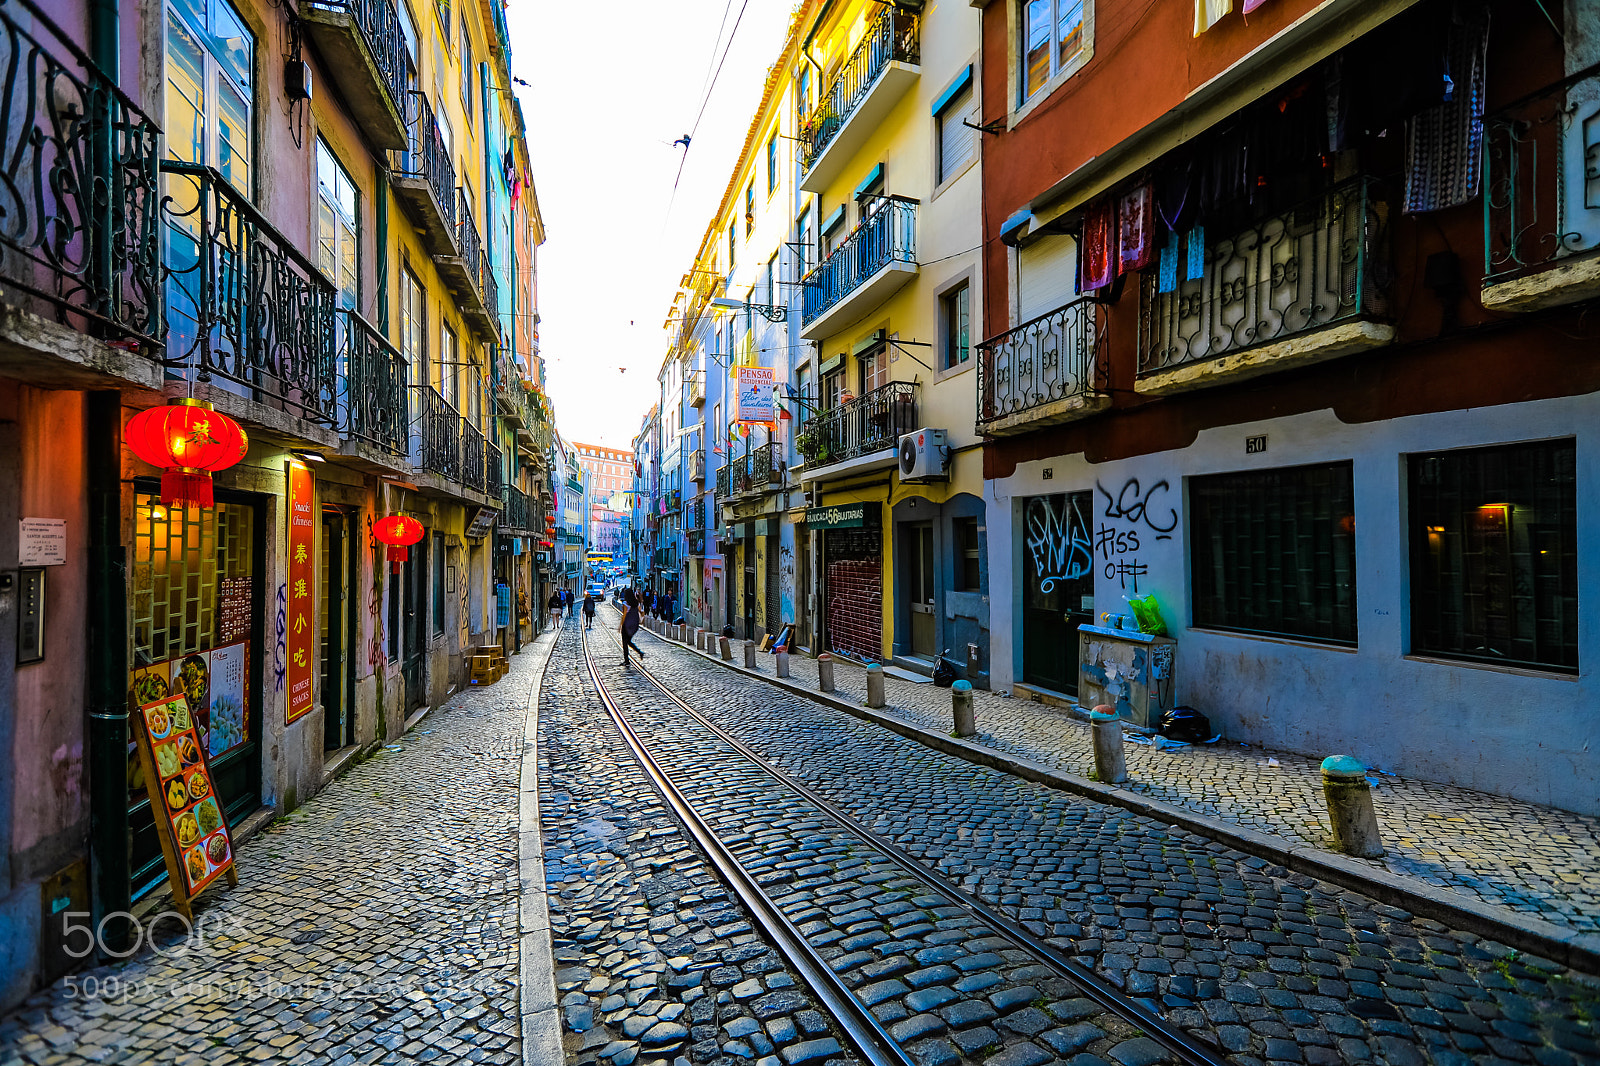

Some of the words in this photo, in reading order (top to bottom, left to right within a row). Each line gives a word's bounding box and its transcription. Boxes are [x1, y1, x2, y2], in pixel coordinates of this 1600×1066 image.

[1248, 437, 1264, 452] 50
[1043, 468, 1052, 479] 52
[828, 508, 839, 525] 56
[292, 678, 310, 694] CHINESE
[292, 690, 310, 707] SNACKS
